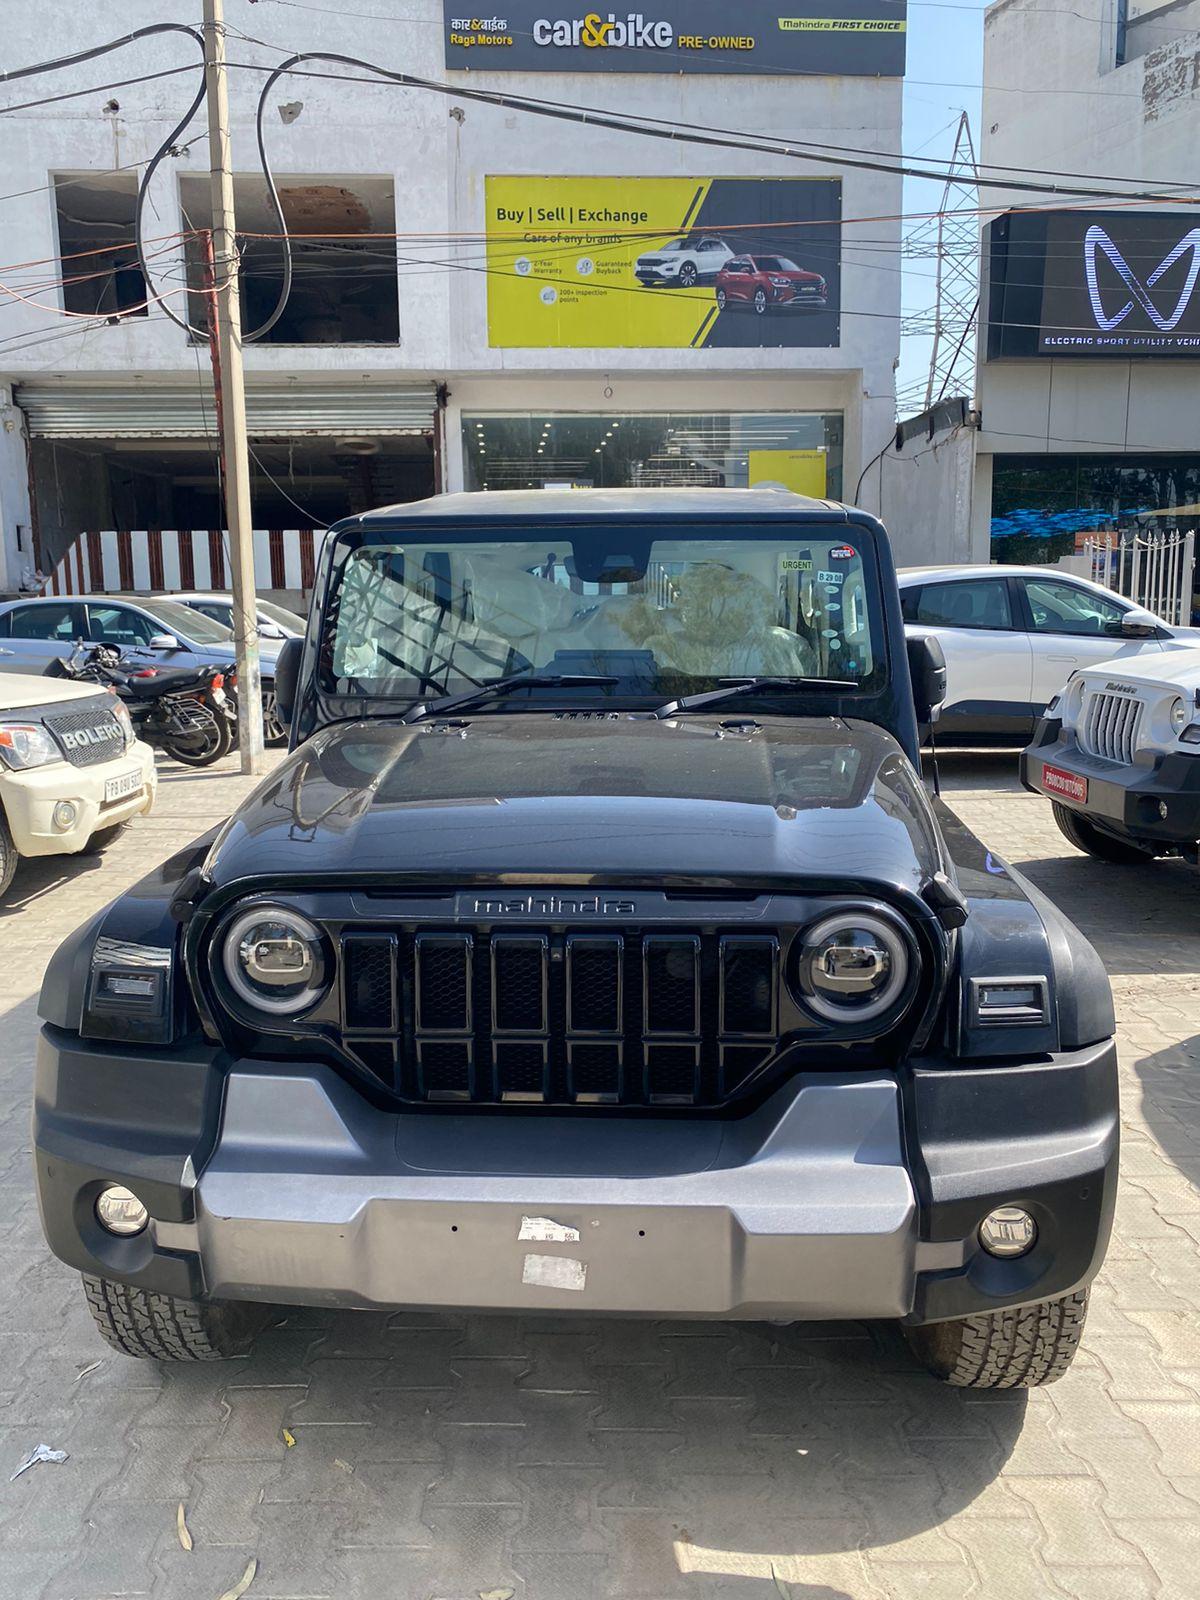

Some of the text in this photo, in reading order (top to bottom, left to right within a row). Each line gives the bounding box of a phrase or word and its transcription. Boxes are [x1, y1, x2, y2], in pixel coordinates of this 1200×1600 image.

[533, 13, 755, 49] car&bike PRE-OWNED
[783, 20, 901, 30] Mahindra FIRST CHOICE
[450, 33, 513, 47] Raga Motors
[497, 208, 524, 223] Buy
[537, 207, 565, 221] Sell
[578, 208, 648, 225] Exchange
[524, 232, 549, 243] Cars
[550, 232, 563, 243] of
[564, 235, 583, 245] any
[1044, 337, 1093, 345] ELECTRIC
[782, 561, 812, 569] URGENT
[61, 723, 124, 749] BOLERO
[474, 896, 636, 913] mahindra
